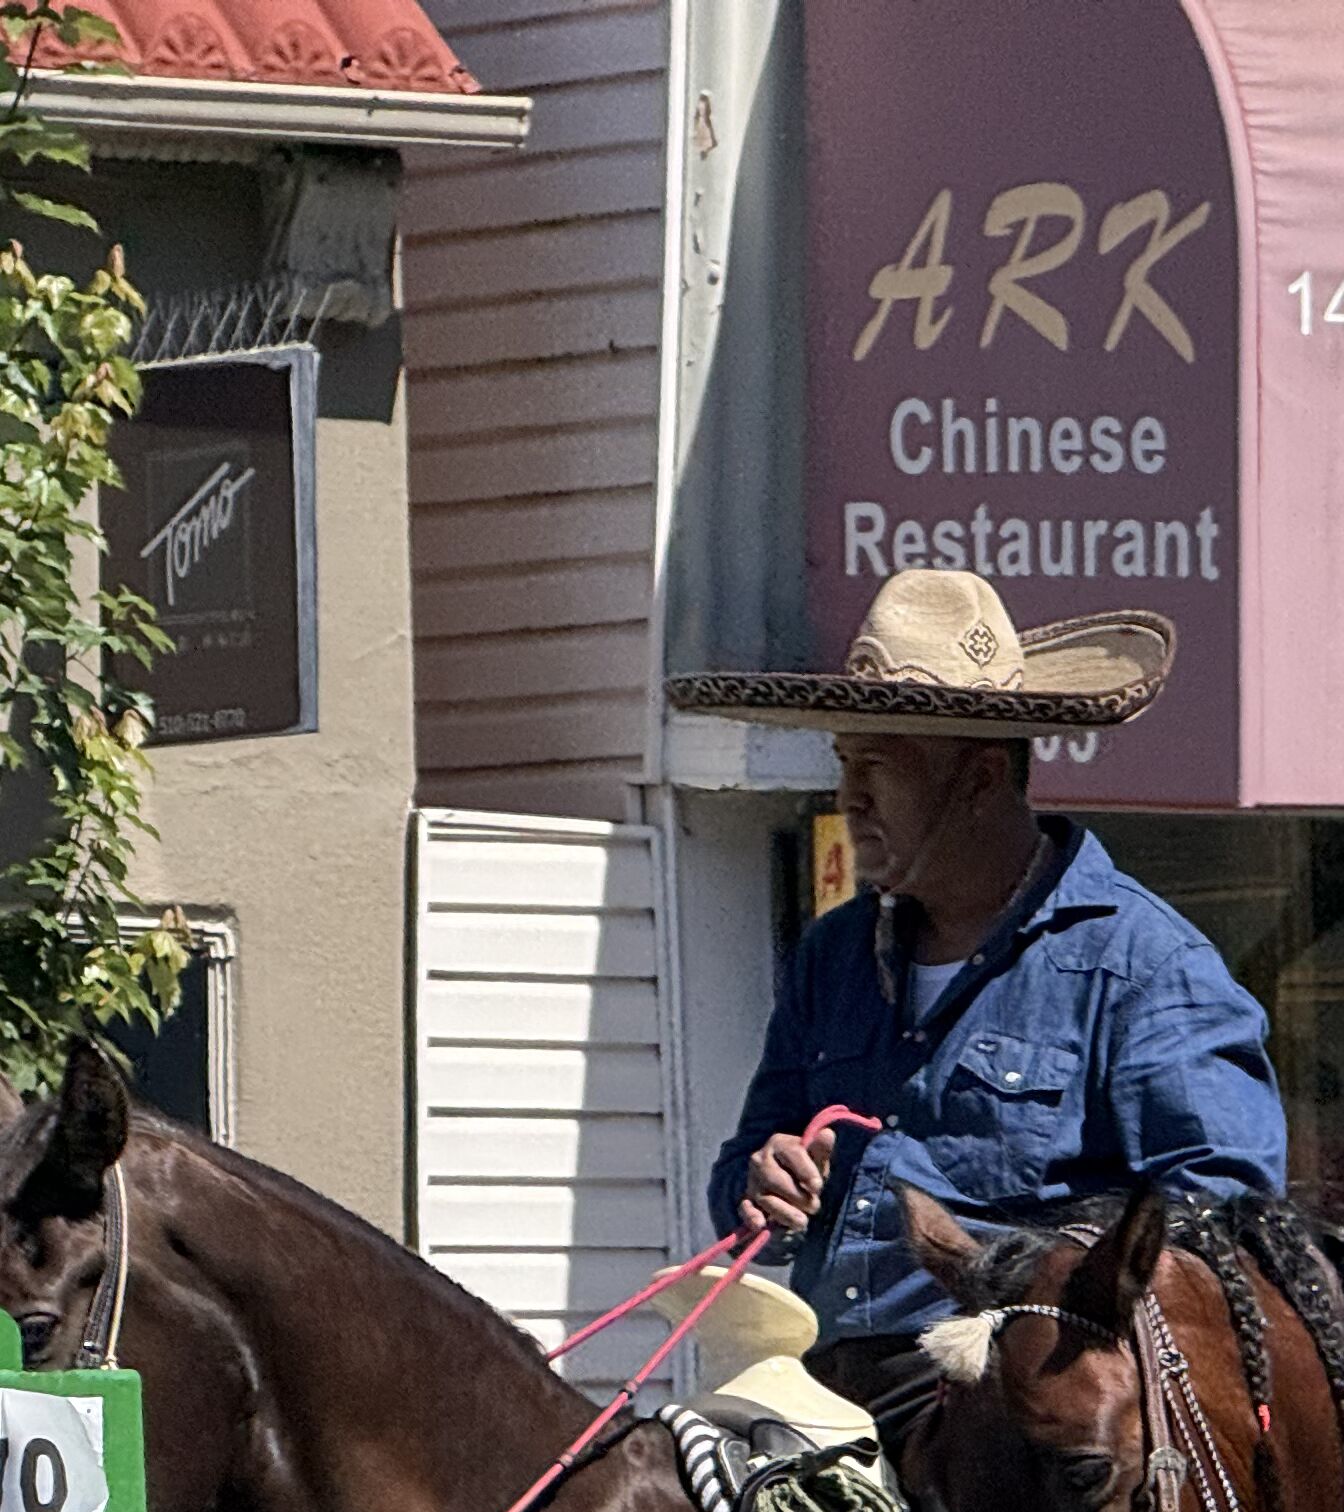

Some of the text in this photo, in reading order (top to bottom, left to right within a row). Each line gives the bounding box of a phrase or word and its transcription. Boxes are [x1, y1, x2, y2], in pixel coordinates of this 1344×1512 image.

[853, 182, 1211, 363] ARK
[889, 398, 1166, 475] Chinese
[844, 502, 1219, 581] Restaurant
